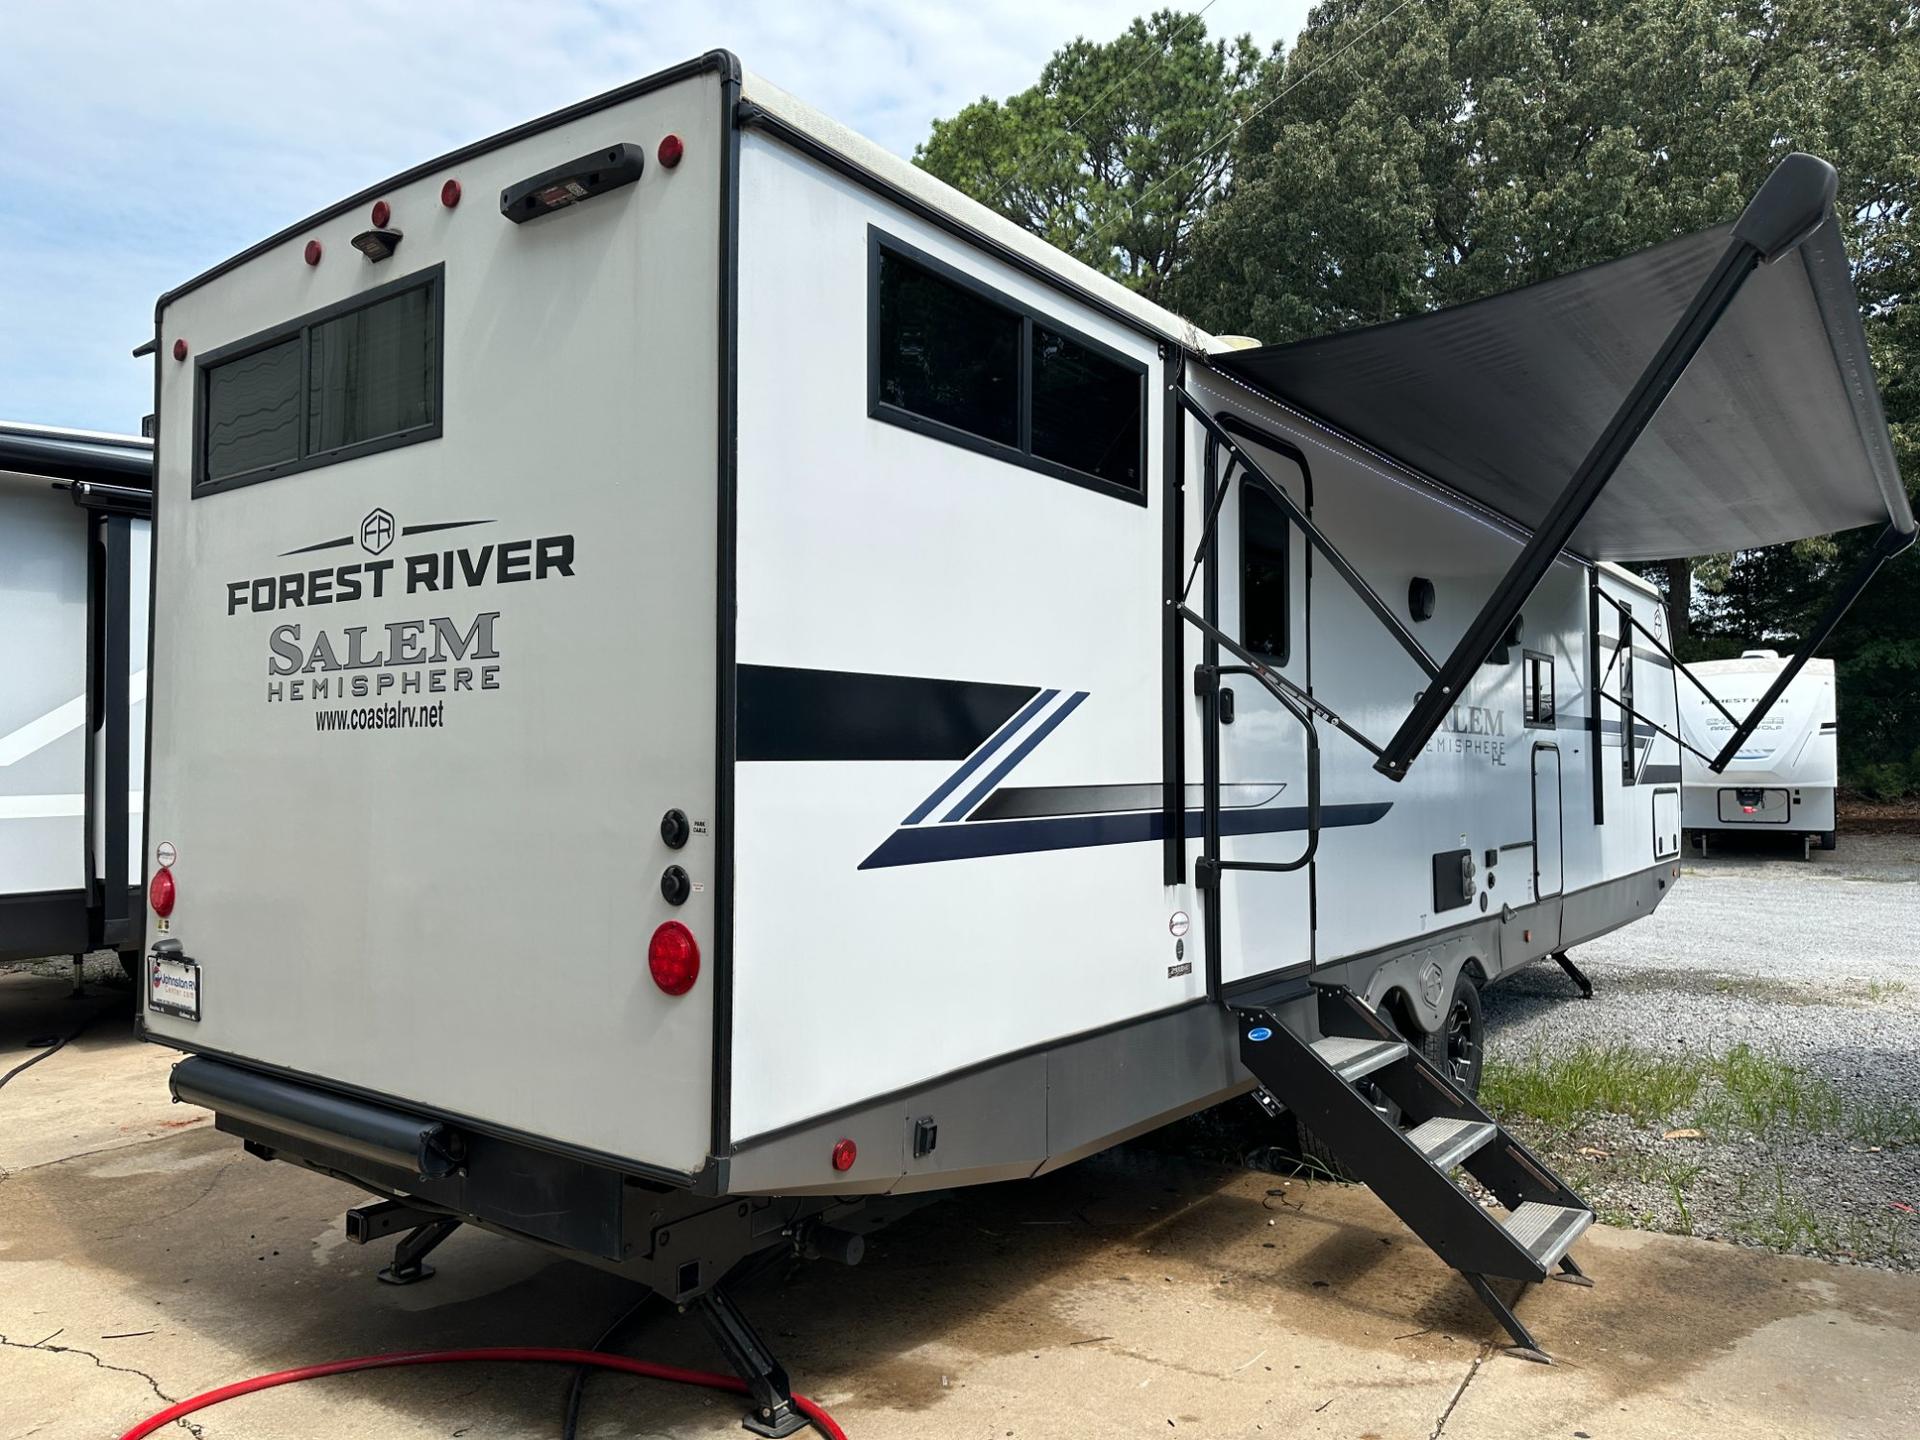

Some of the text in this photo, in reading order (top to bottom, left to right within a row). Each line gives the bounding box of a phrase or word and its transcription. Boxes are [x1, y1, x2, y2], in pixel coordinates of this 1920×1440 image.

[226, 534, 575, 615] FOREST RIVER
[268, 611, 501, 676] SALEM
[267, 665, 500, 702] HEMISPHERE
[316, 700, 444, 731] www.coastalrv.net
